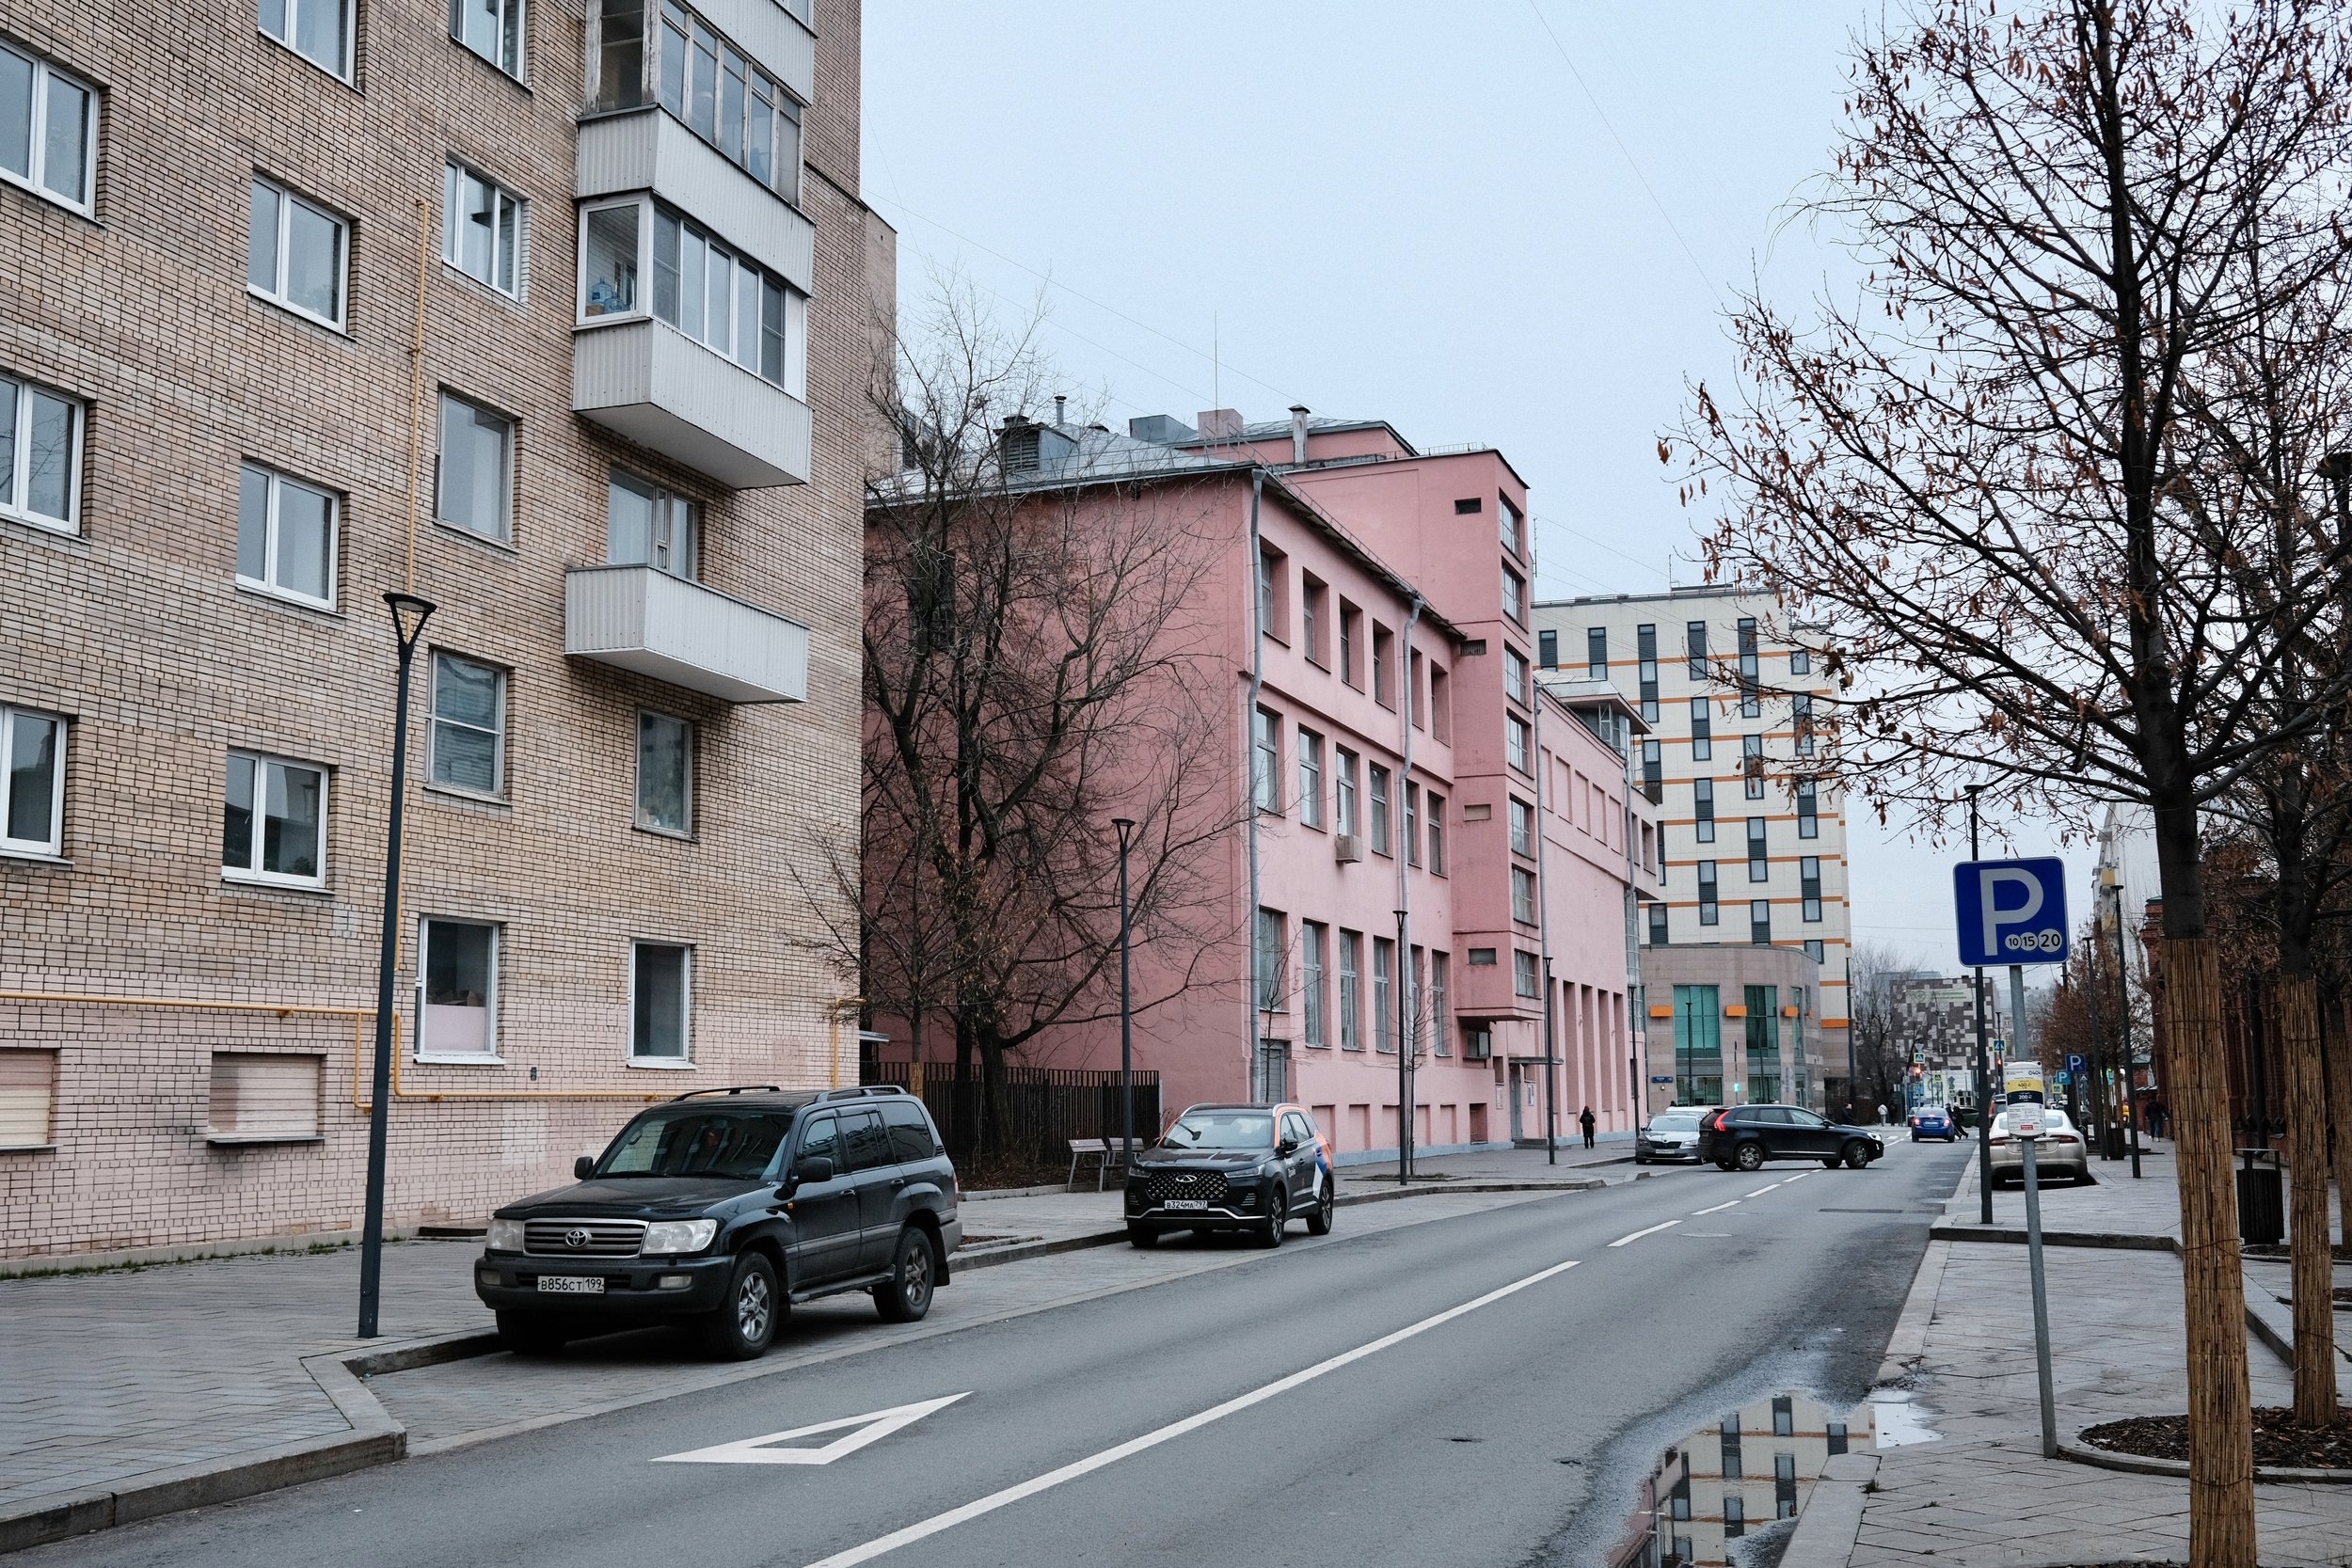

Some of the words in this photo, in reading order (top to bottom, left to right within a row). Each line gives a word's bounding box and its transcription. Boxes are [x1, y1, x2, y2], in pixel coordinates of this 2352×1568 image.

[1979, 867, 2044, 956] P
[2008, 938, 2019, 946] 10
[2024, 936, 2036, 946] 15
[2041, 934, 2060, 947] 20
[2070, 1055, 2081, 1070] P
[2058, 1072, 2068, 1083] P
[585, 1278, 602, 1289] 199
